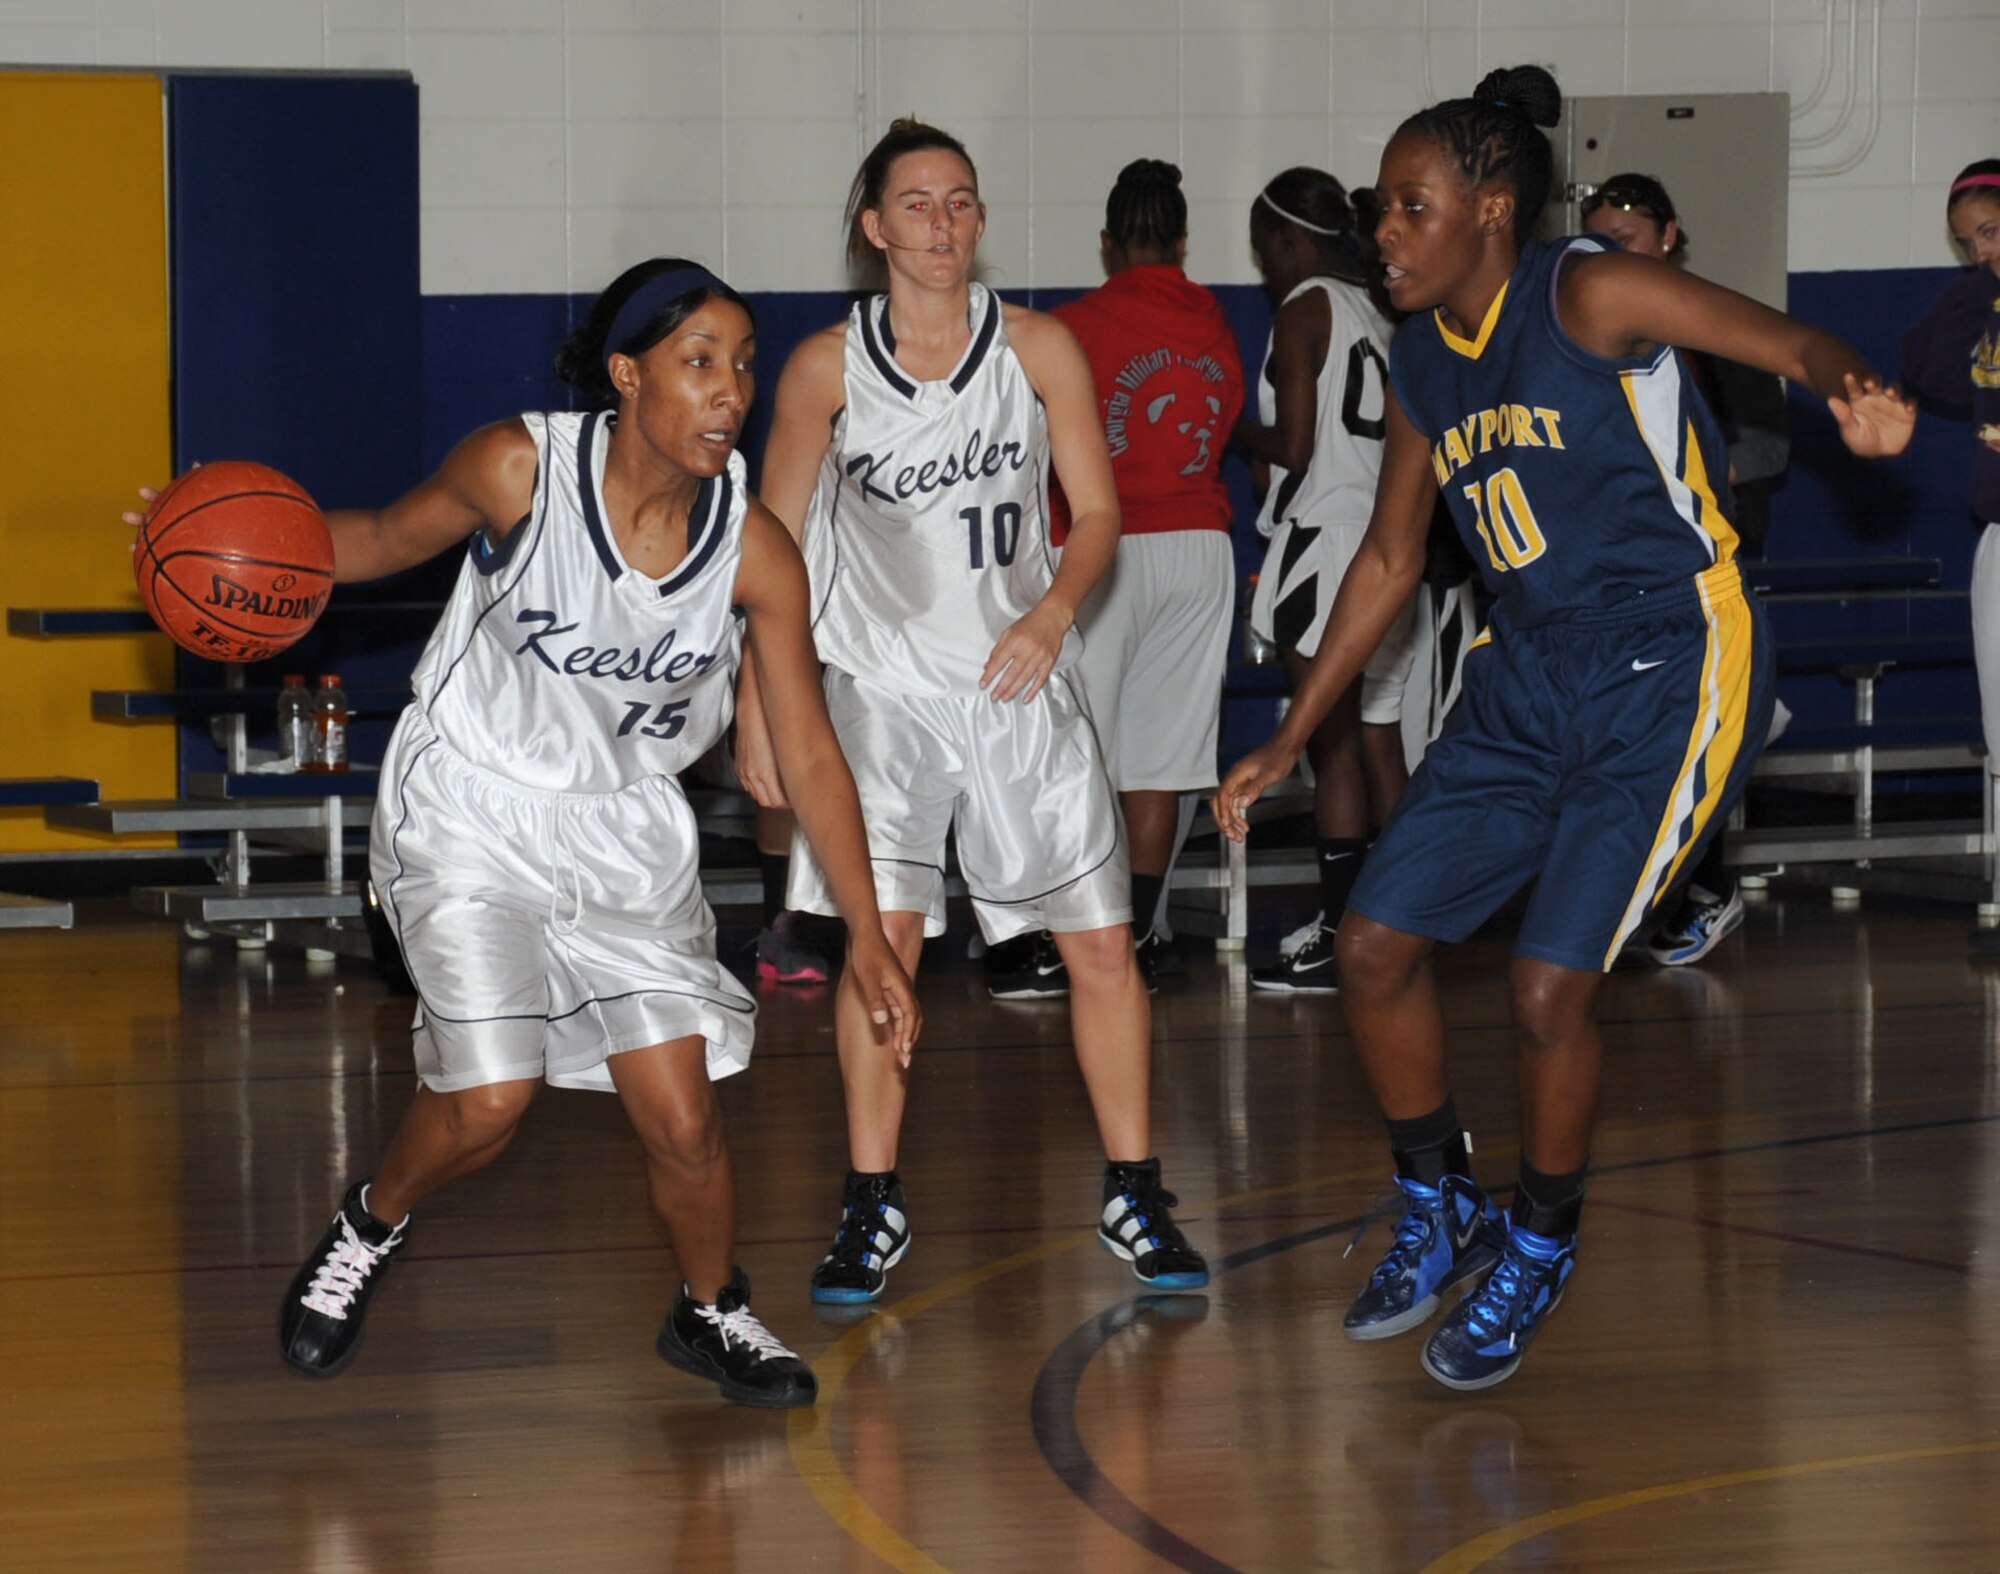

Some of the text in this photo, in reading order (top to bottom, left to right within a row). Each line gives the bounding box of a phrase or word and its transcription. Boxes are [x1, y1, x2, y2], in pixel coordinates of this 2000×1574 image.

[846, 428, 1028, 504] Keesler
[1432, 404, 1566, 489] MAYPORT
[959, 502, 1022, 569] 10
[1463, 467, 1547, 572] 10
[515, 608, 717, 683] Keesler
[616, 697, 692, 740] 15
